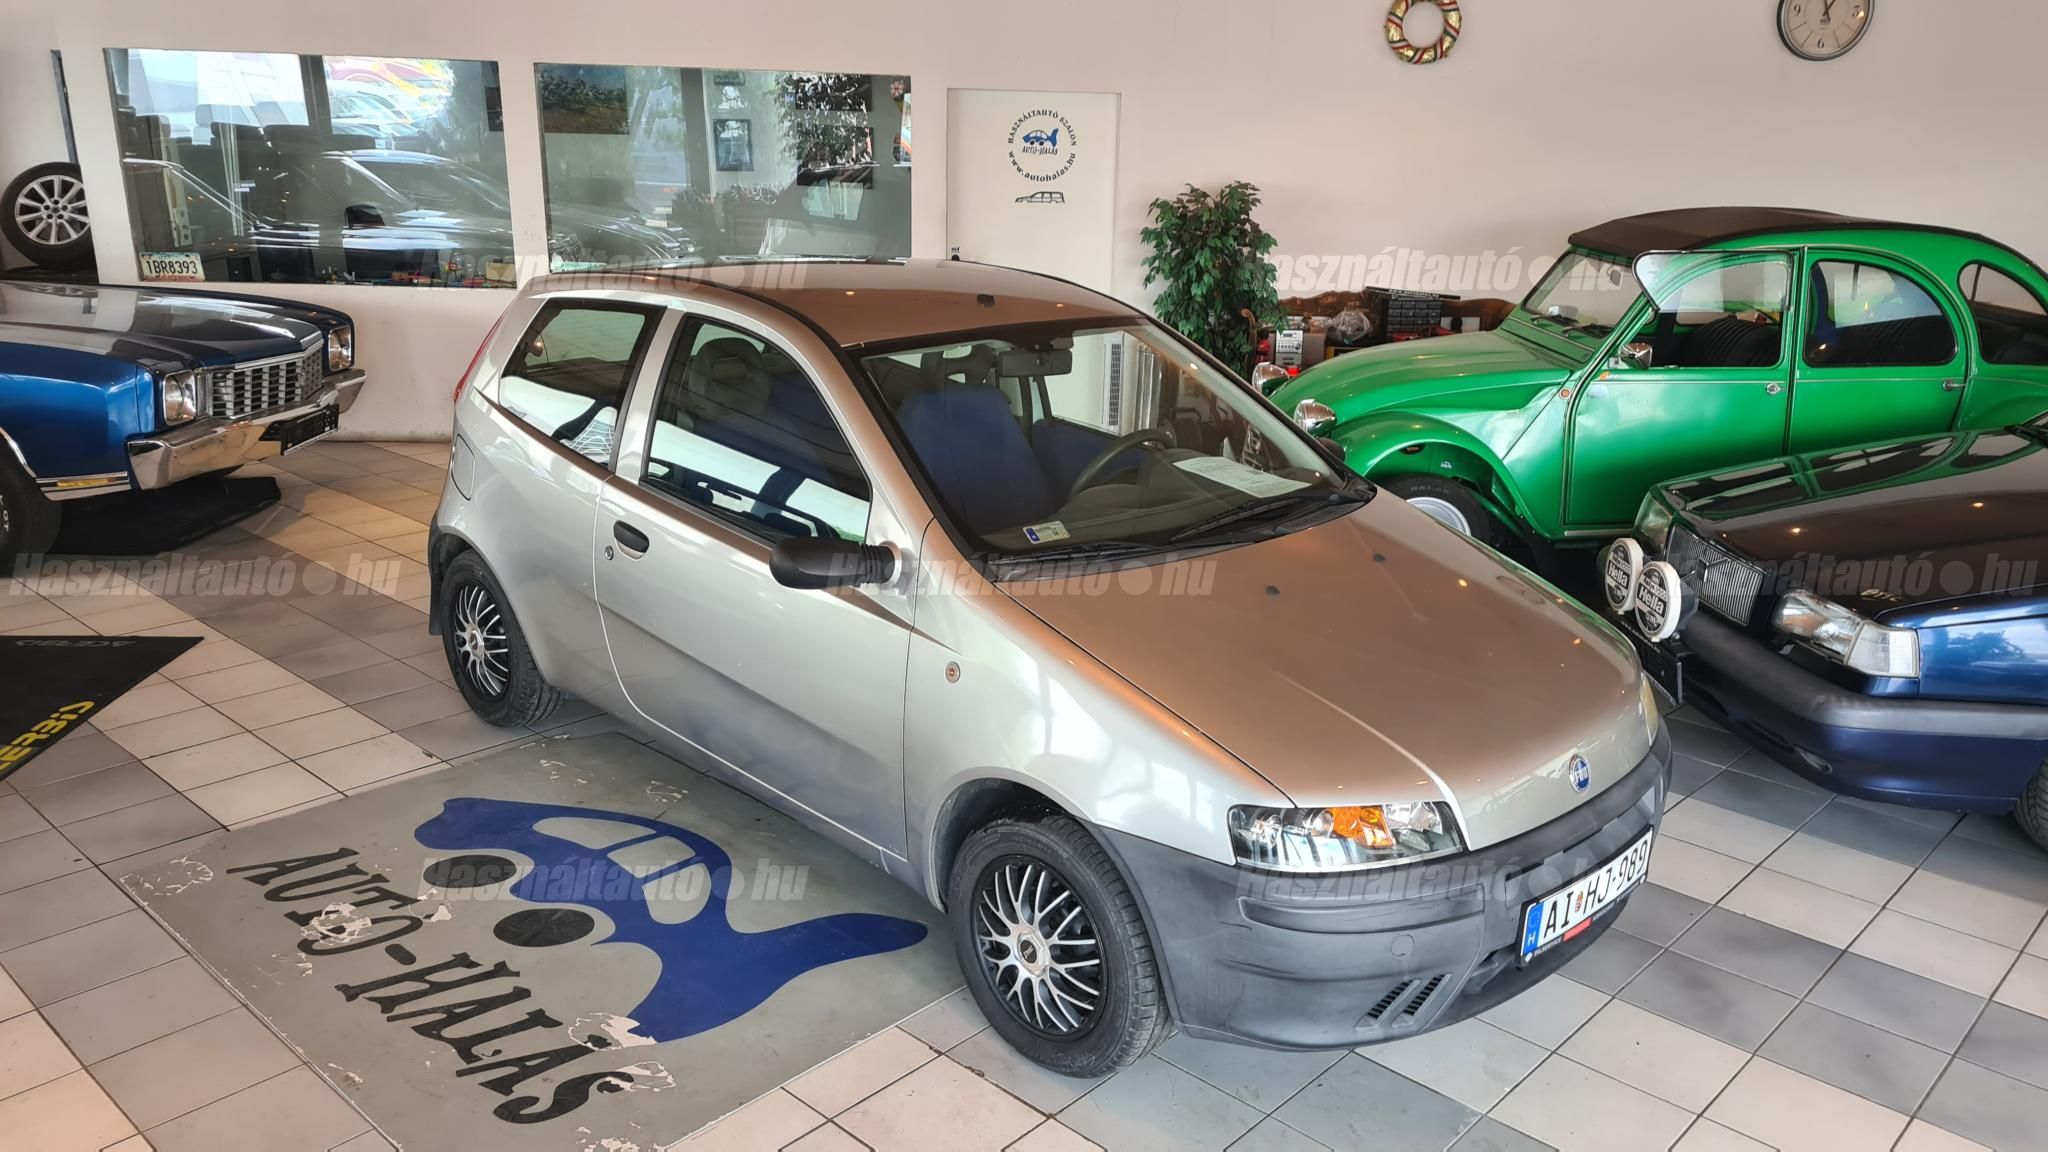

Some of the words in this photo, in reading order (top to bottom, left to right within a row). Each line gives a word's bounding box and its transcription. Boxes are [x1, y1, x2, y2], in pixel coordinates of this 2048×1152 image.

[1817, 37, 1825, 49] 6
[1008, 108, 1059, 144] HASZNÁLTAUTÓ
[1058, 116, 1077, 146] SZALON
[1008, 150, 1076, 182] www.autohalas.hu
[145, 260, 198, 274] 1BR8393
[1608, 562, 1629, 588] Hella
[1638, 586, 1665, 616] Hella
[1543, 890, 1575, 939] AI
[1583, 838, 1649, 915] HJ-989
[1527, 931, 1536, 947] H
